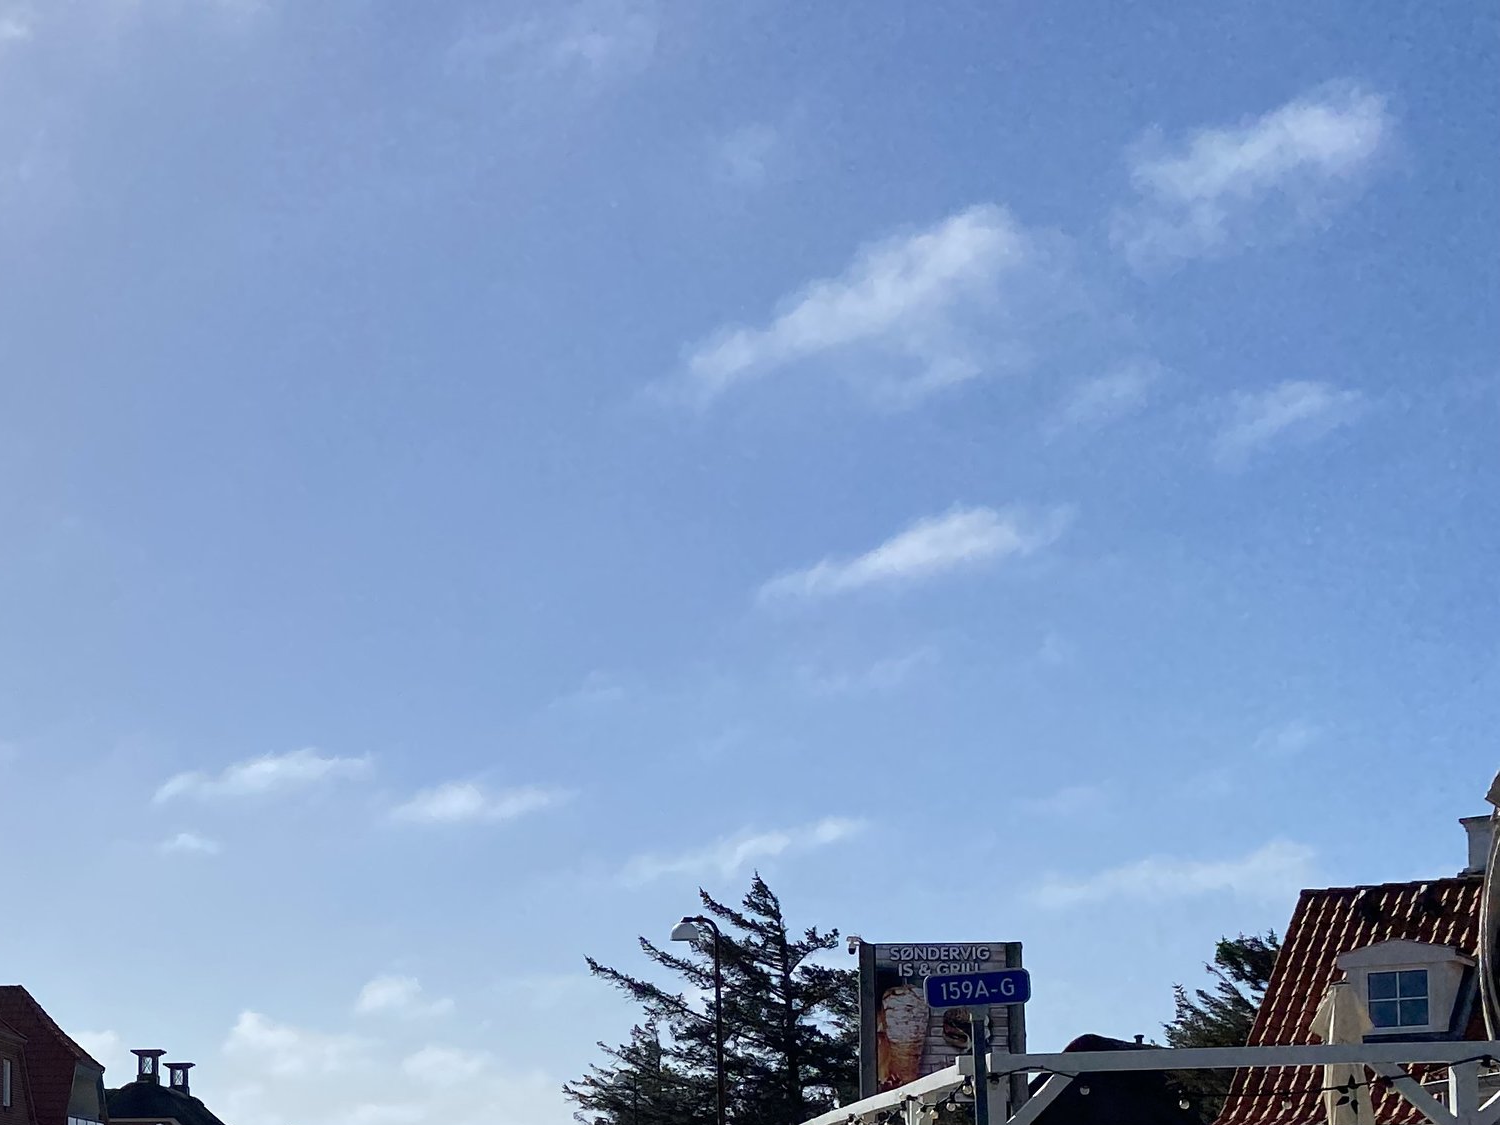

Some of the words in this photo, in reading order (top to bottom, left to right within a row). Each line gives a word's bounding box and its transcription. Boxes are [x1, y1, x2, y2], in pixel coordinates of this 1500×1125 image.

[890, 946, 990, 961] SØNDERVIG
[898, 963, 914, 977] IS
[918, 963, 932, 977] &
[941, 978, 1015, 1000] 159A-G
